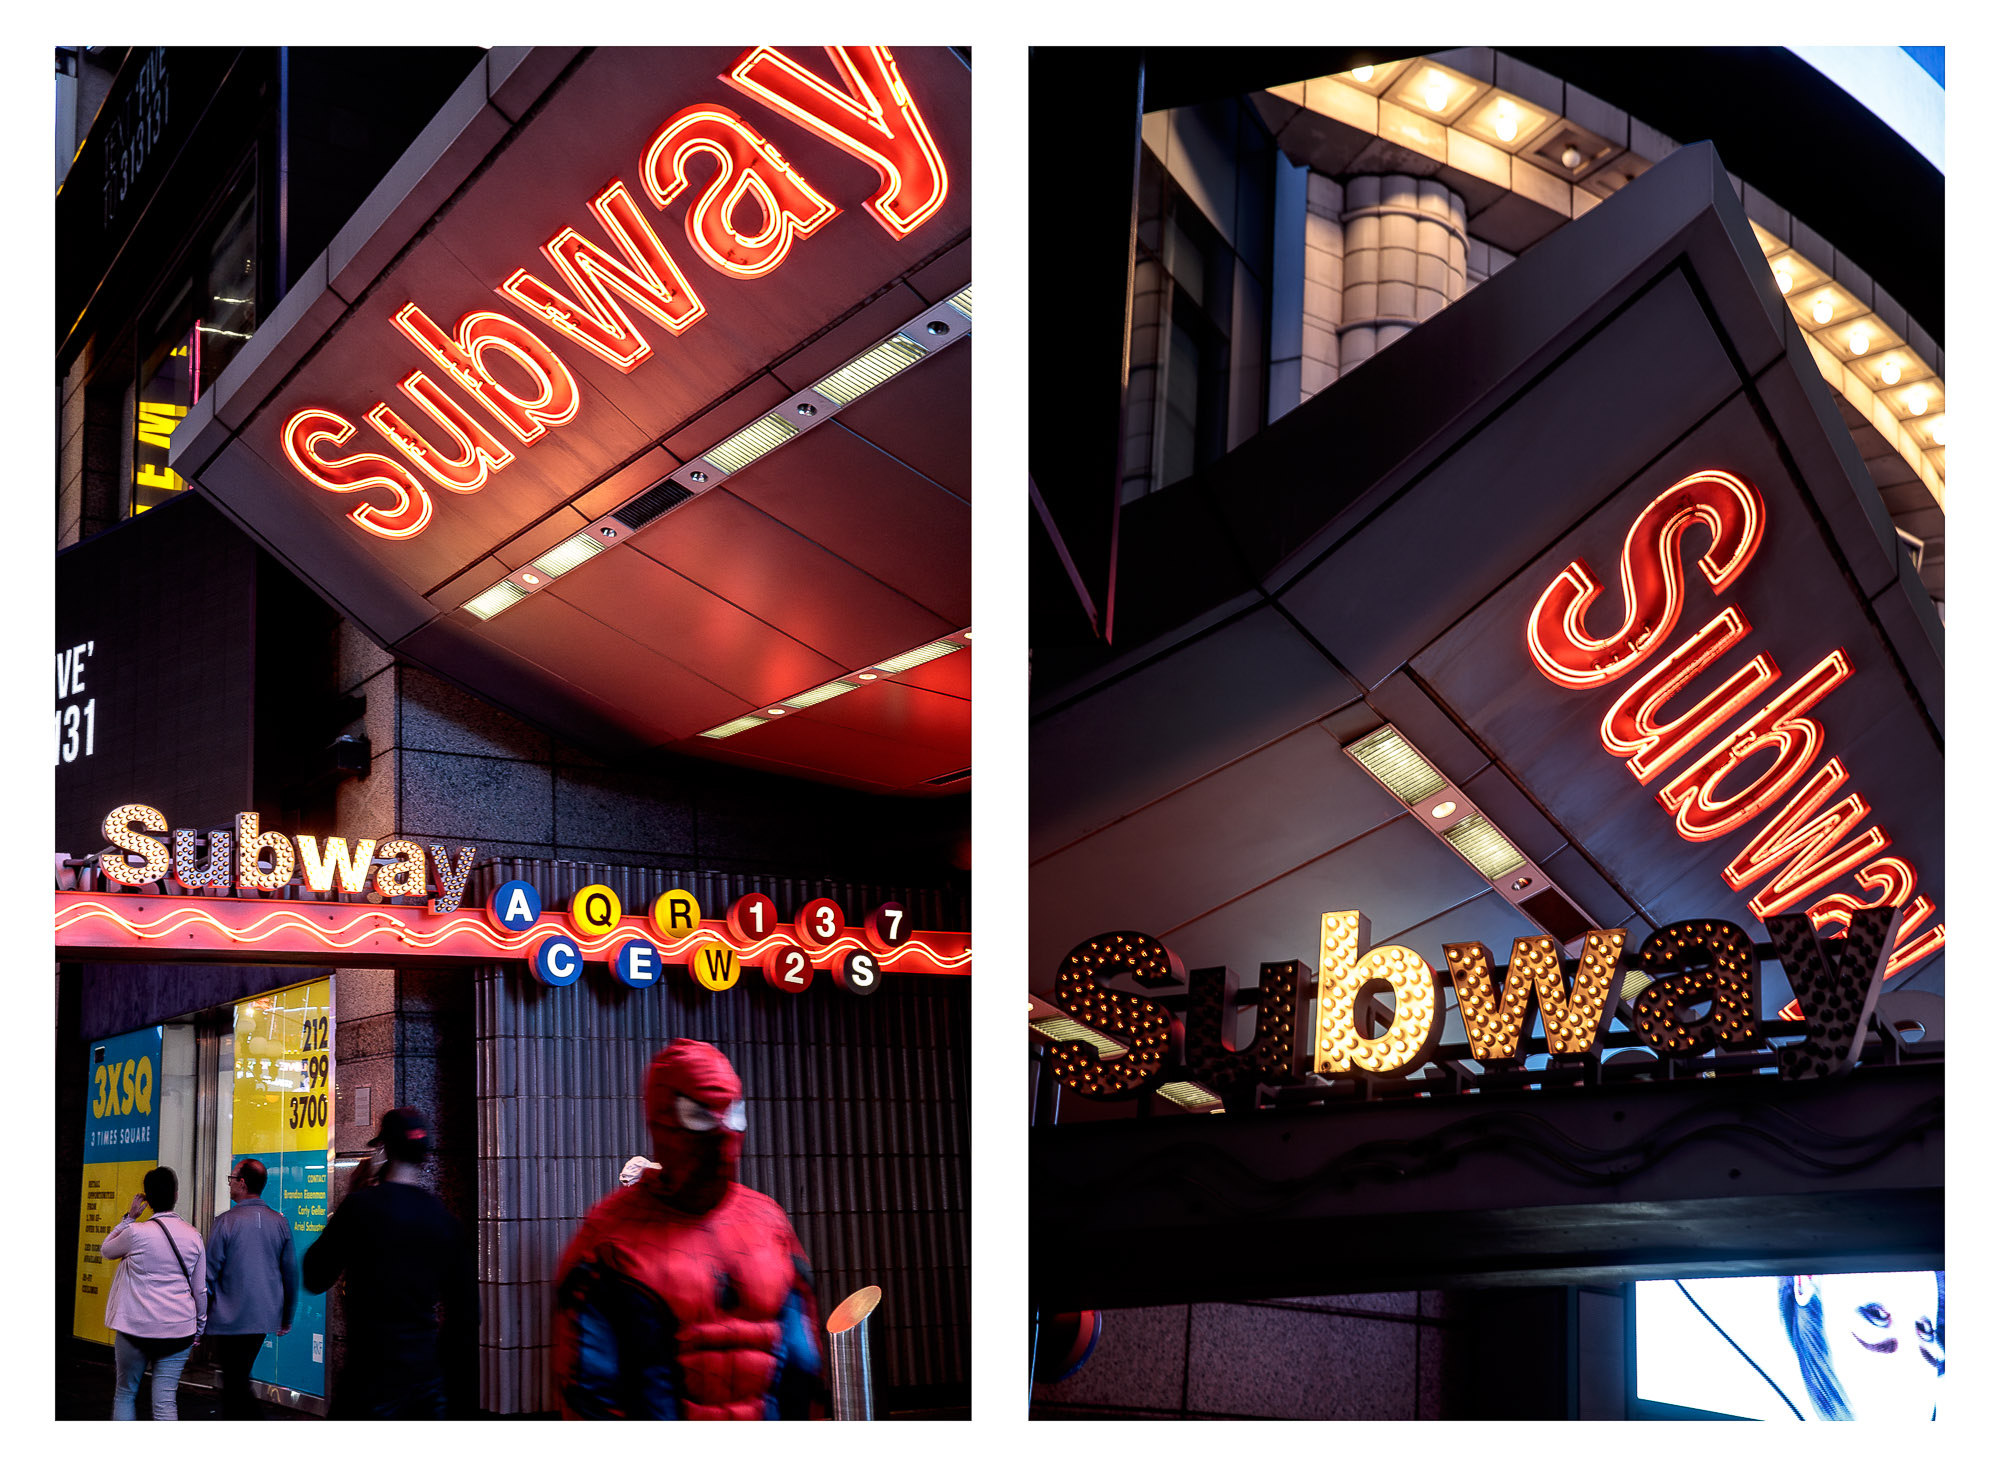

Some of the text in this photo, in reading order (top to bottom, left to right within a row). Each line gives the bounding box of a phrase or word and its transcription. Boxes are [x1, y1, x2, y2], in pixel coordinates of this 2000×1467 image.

[280, 46, 949, 541] Subway
[55, 641, 94, 699] VE'
[100, 803, 477, 915] Subway
[505, 888, 903, 940] A Q R 1 3 7
[546, 944, 874, 987] C E W 2 S
[1048, 908, 1903, 1101] Subway
[303, 1016, 328, 1052] 212
[93, 1056, 152, 1118] 3XSQ
[289, 1094, 327, 1129] 3700
[91, 1126, 150, 1147] 3 TIMES SQUARE
